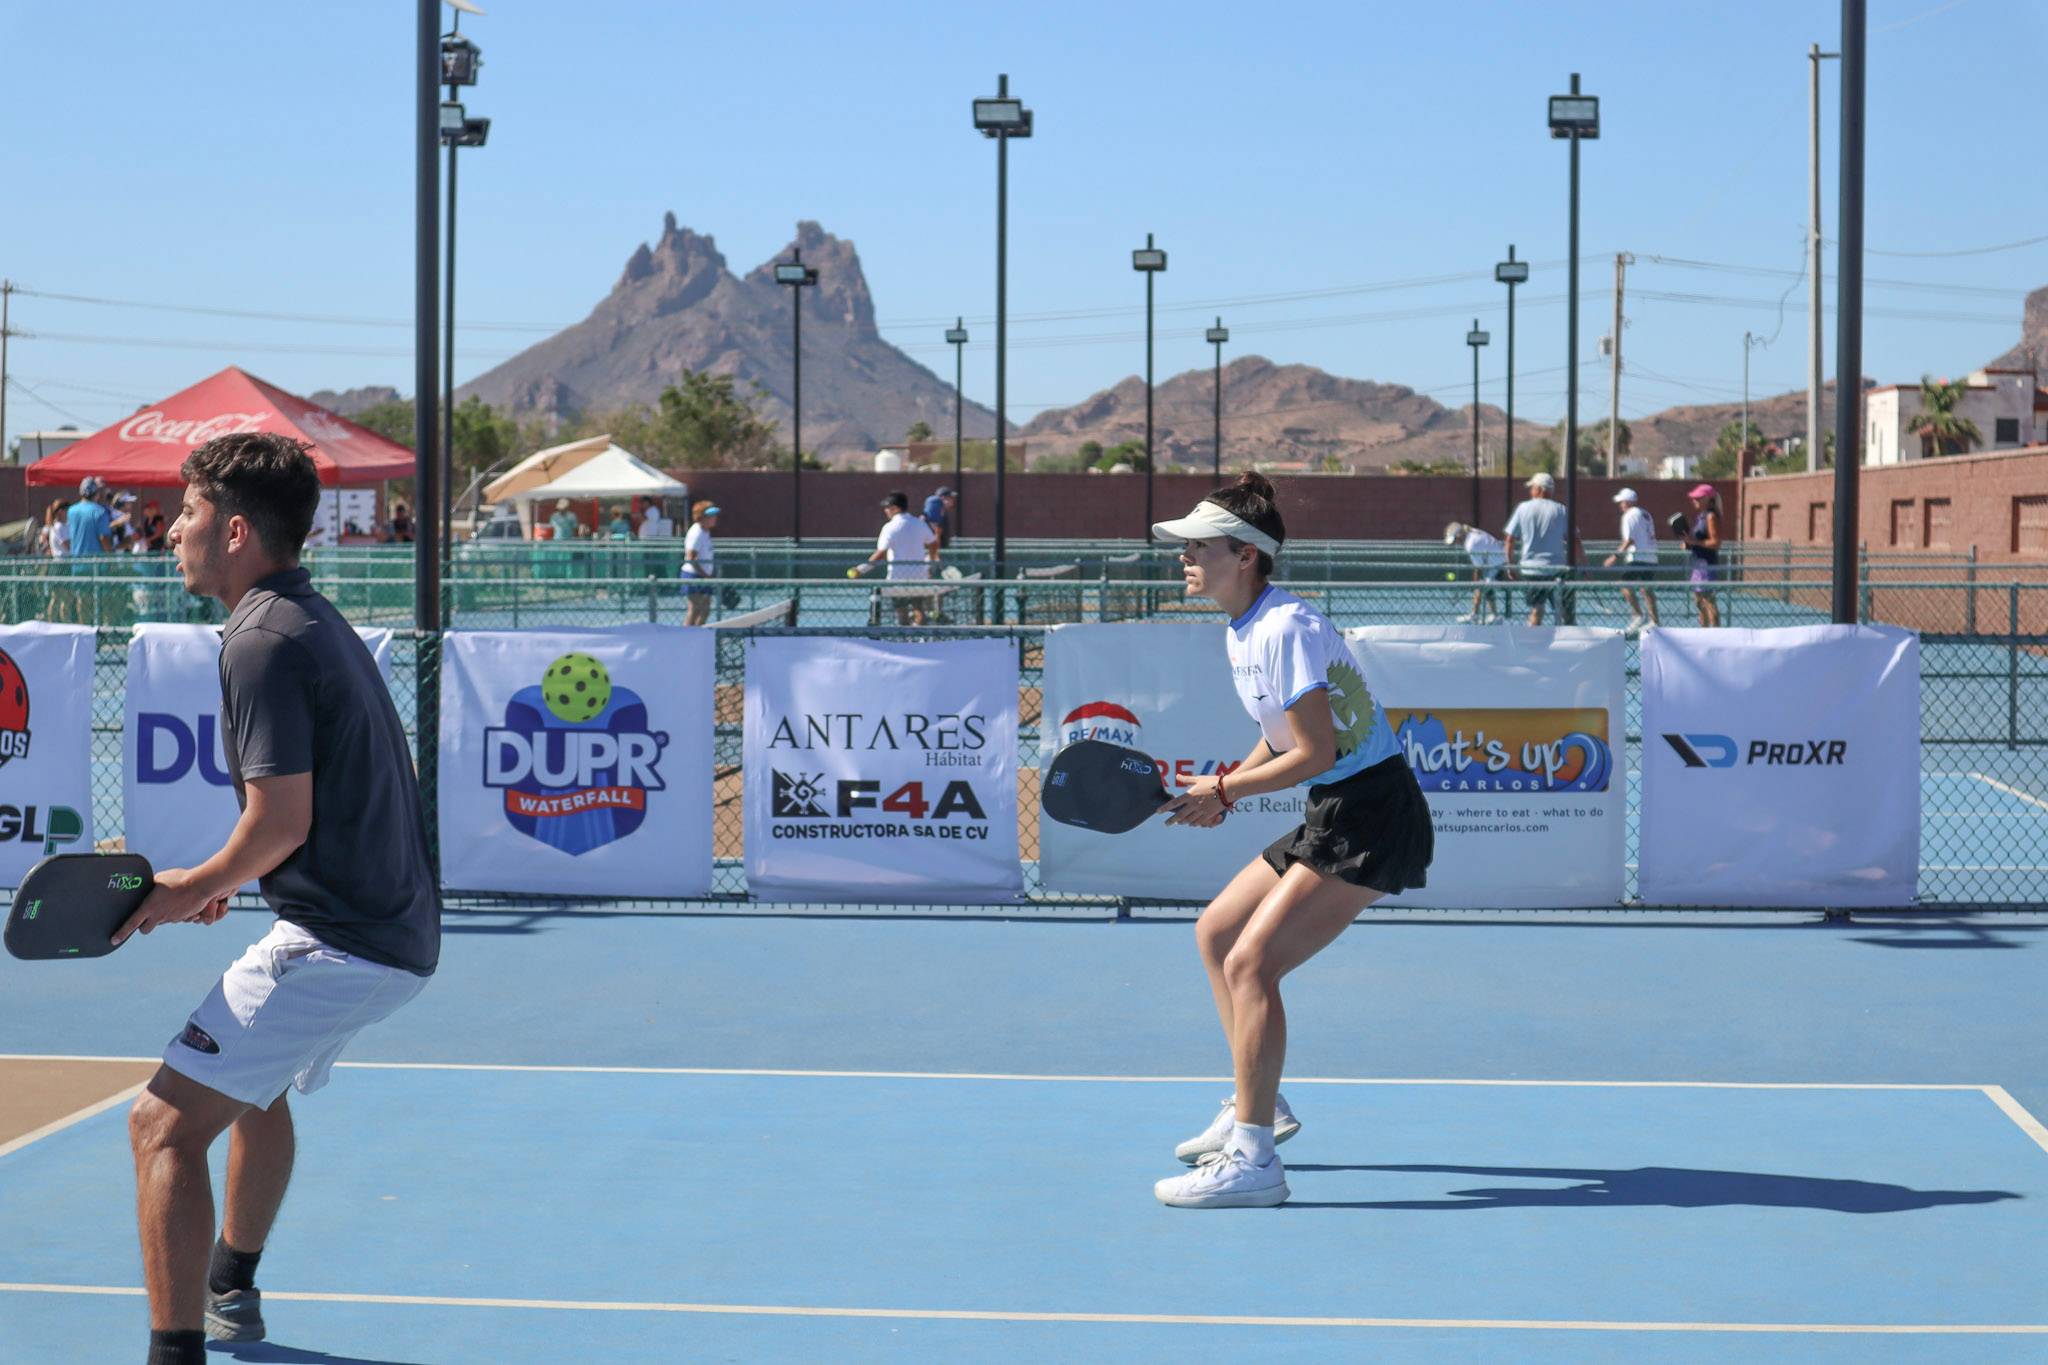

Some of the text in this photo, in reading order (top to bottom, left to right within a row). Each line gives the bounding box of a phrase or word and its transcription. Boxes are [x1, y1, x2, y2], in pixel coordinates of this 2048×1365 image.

[0, 730, 28, 757] OS
[767, 714, 986, 750] ANTARES
[1069, 726, 1134, 746] RE/MAX
[137, 713, 232, 786] DU
[485, 729, 663, 789] DUPR
[925, 752, 982, 767] Hábitat
[1402, 729, 1510, 773] hat's
[1441, 780, 1540, 791] CARLOS
[519, 790, 632, 813] WATERFALL
[837, 780, 988, 819] F4A
[1234, 801, 1254, 813] ce
[1431, 807, 1604, 819] ay where to eat what to do
[772, 824, 989, 840] CONSTRUCTORA SA DE CV
